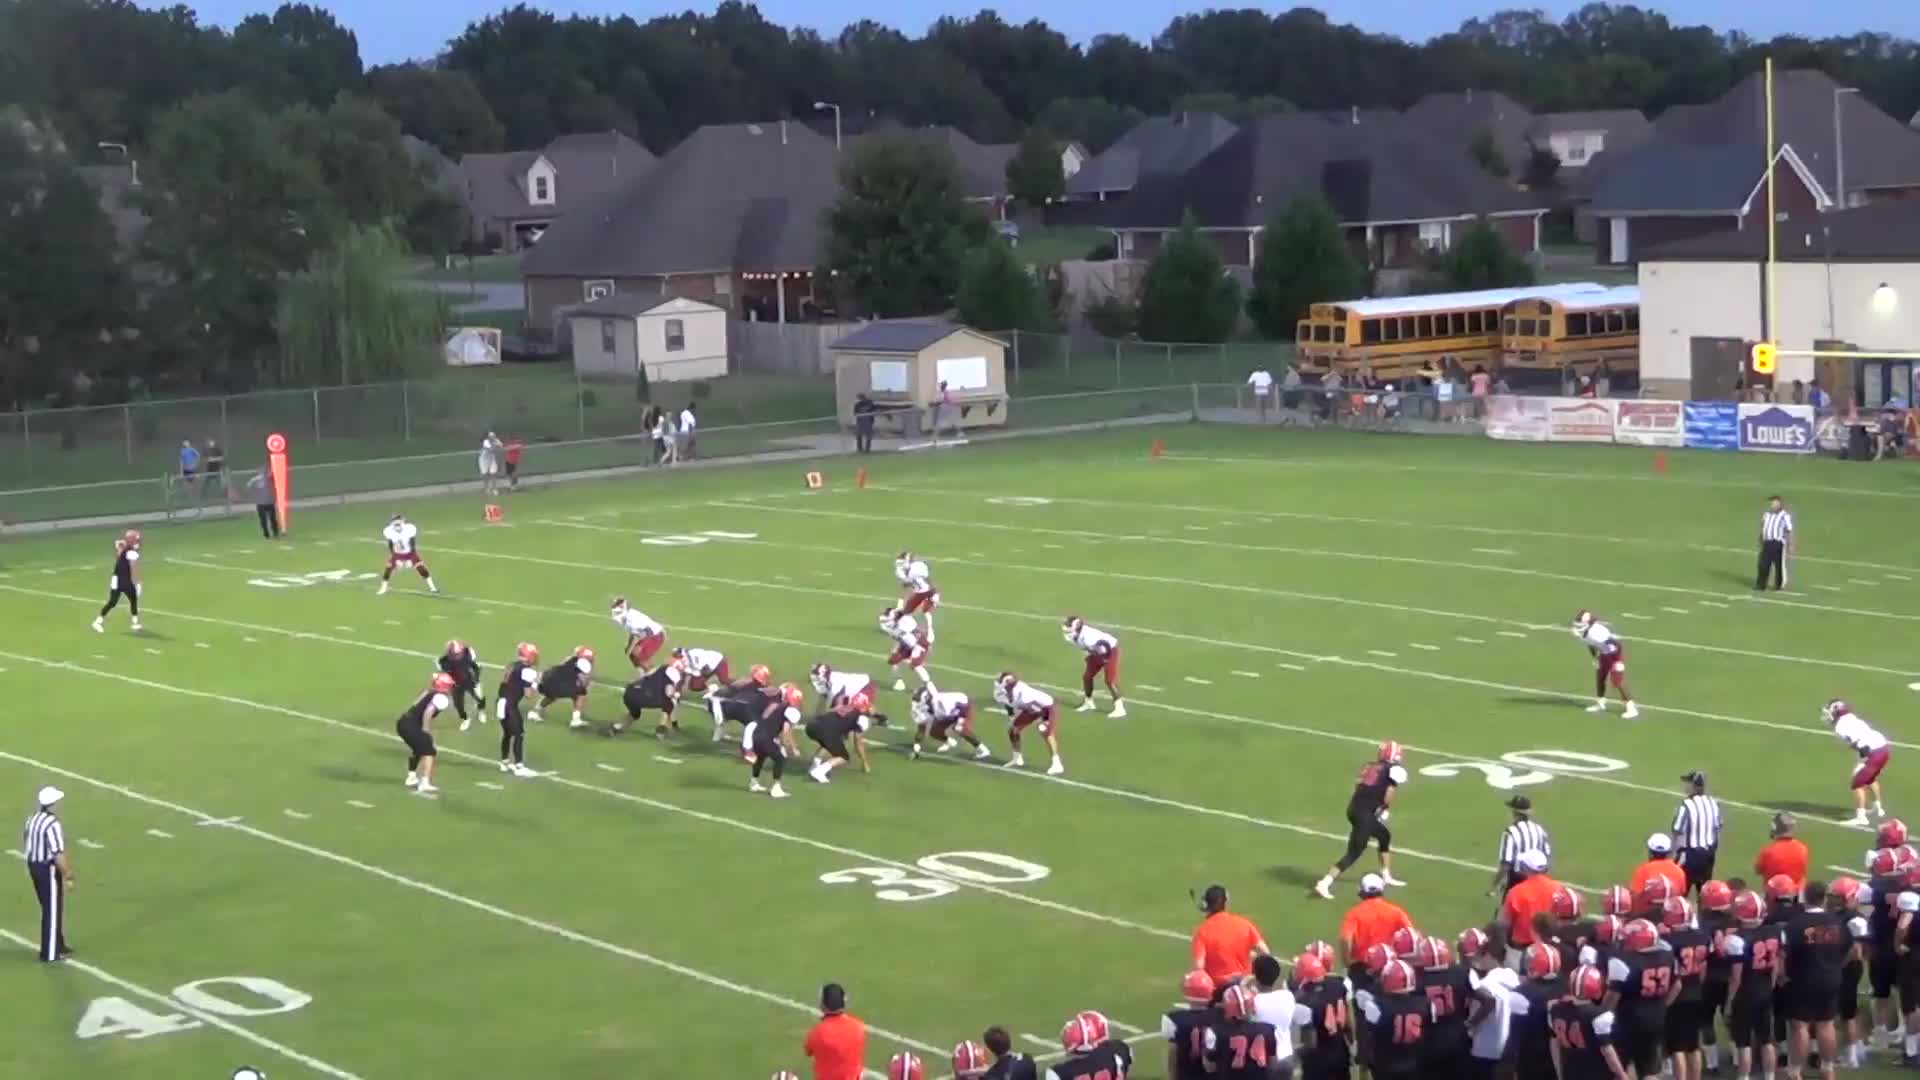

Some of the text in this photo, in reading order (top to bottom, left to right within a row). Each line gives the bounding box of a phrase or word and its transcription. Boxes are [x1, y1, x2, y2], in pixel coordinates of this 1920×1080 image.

[1747, 422, 1806, 446] LOWE'S
[1419, 750, 1629, 789] 20
[819, 851, 1051, 901] 30
[76, 976, 312, 1038] 40
[1229, 1032, 1268, 1069] 74
